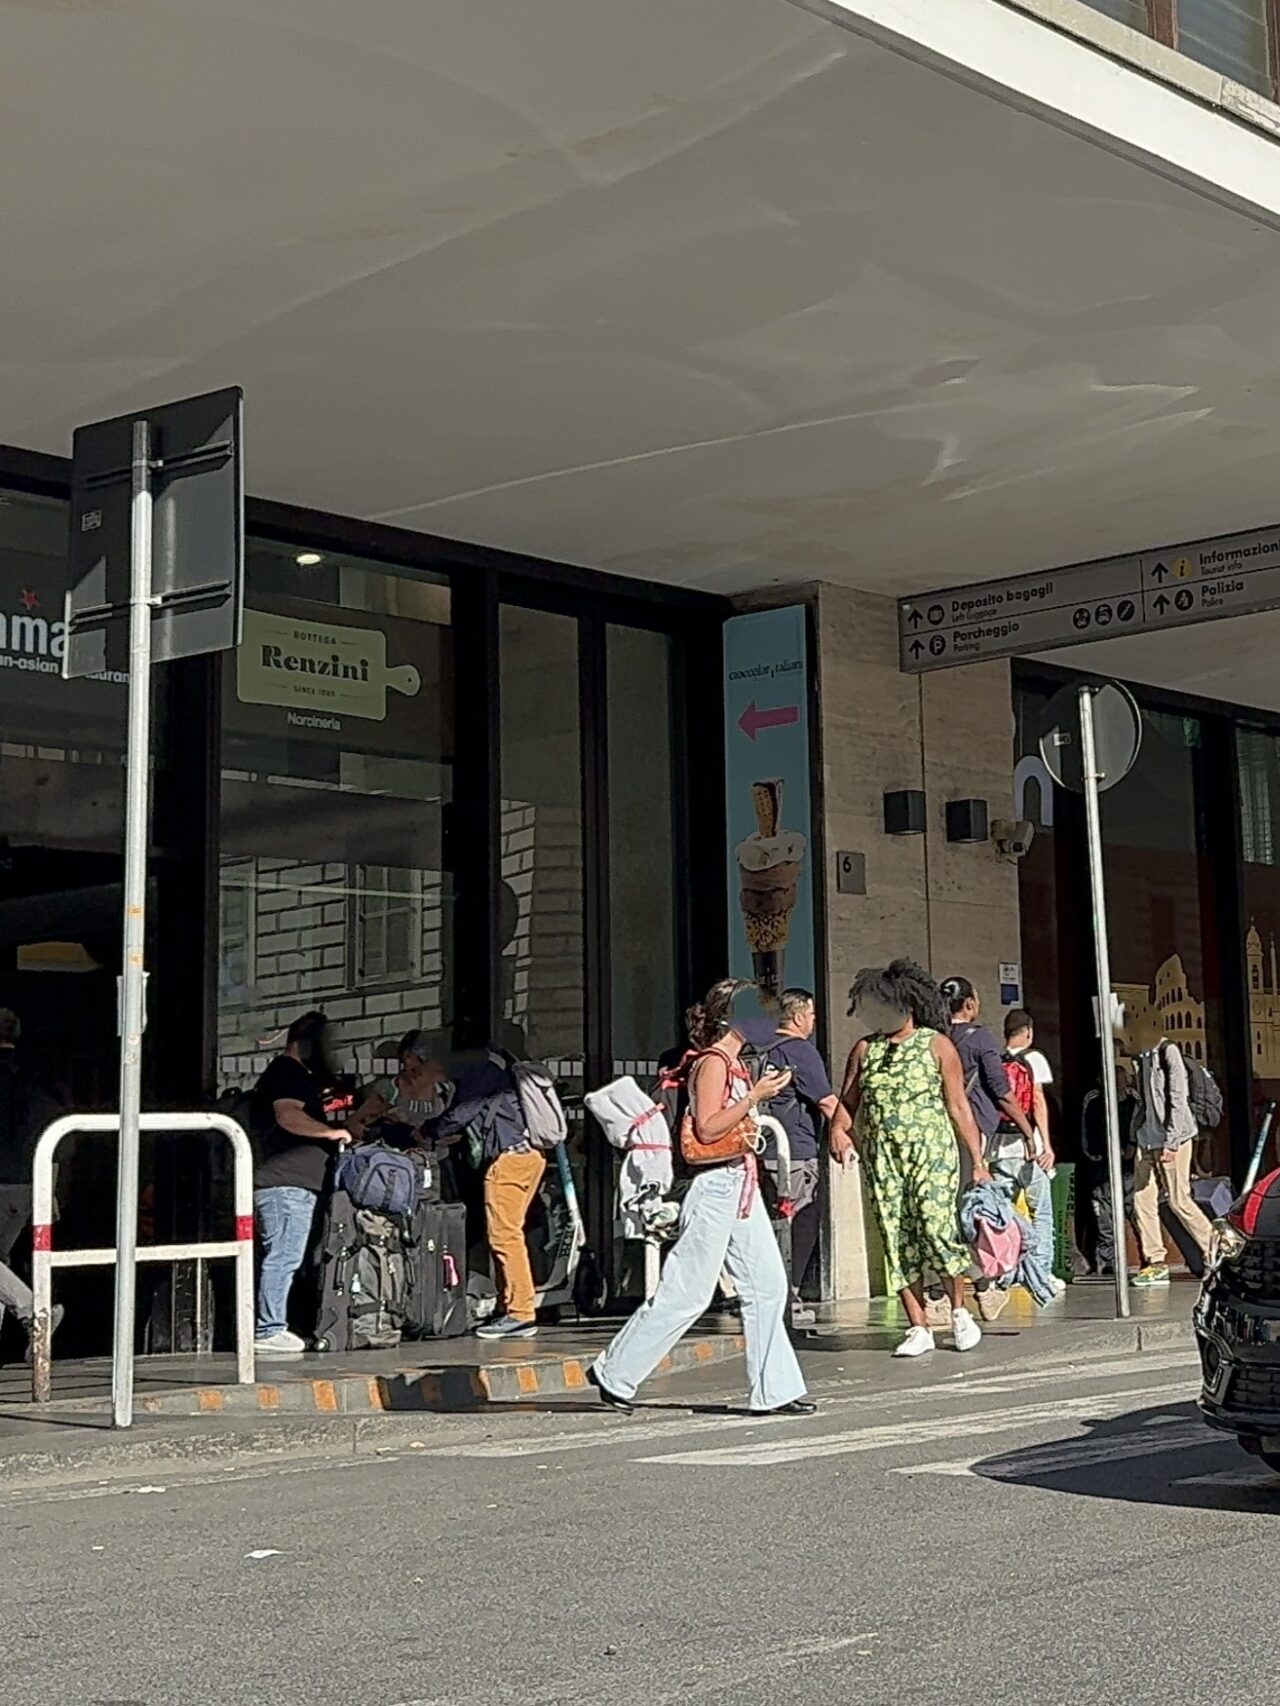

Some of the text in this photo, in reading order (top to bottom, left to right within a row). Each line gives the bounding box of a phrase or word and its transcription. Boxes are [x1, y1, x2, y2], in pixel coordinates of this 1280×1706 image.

[951, 581, 1054, 613] Deposito bagagli
[1201, 579, 1244, 597] Polizia
[293, 630, 337, 645] BOTTEGA
[952, 620, 1020, 643] Parcheggio
[261, 644, 369, 682] Renzini
[287, 712, 341, 731] Norcineria
